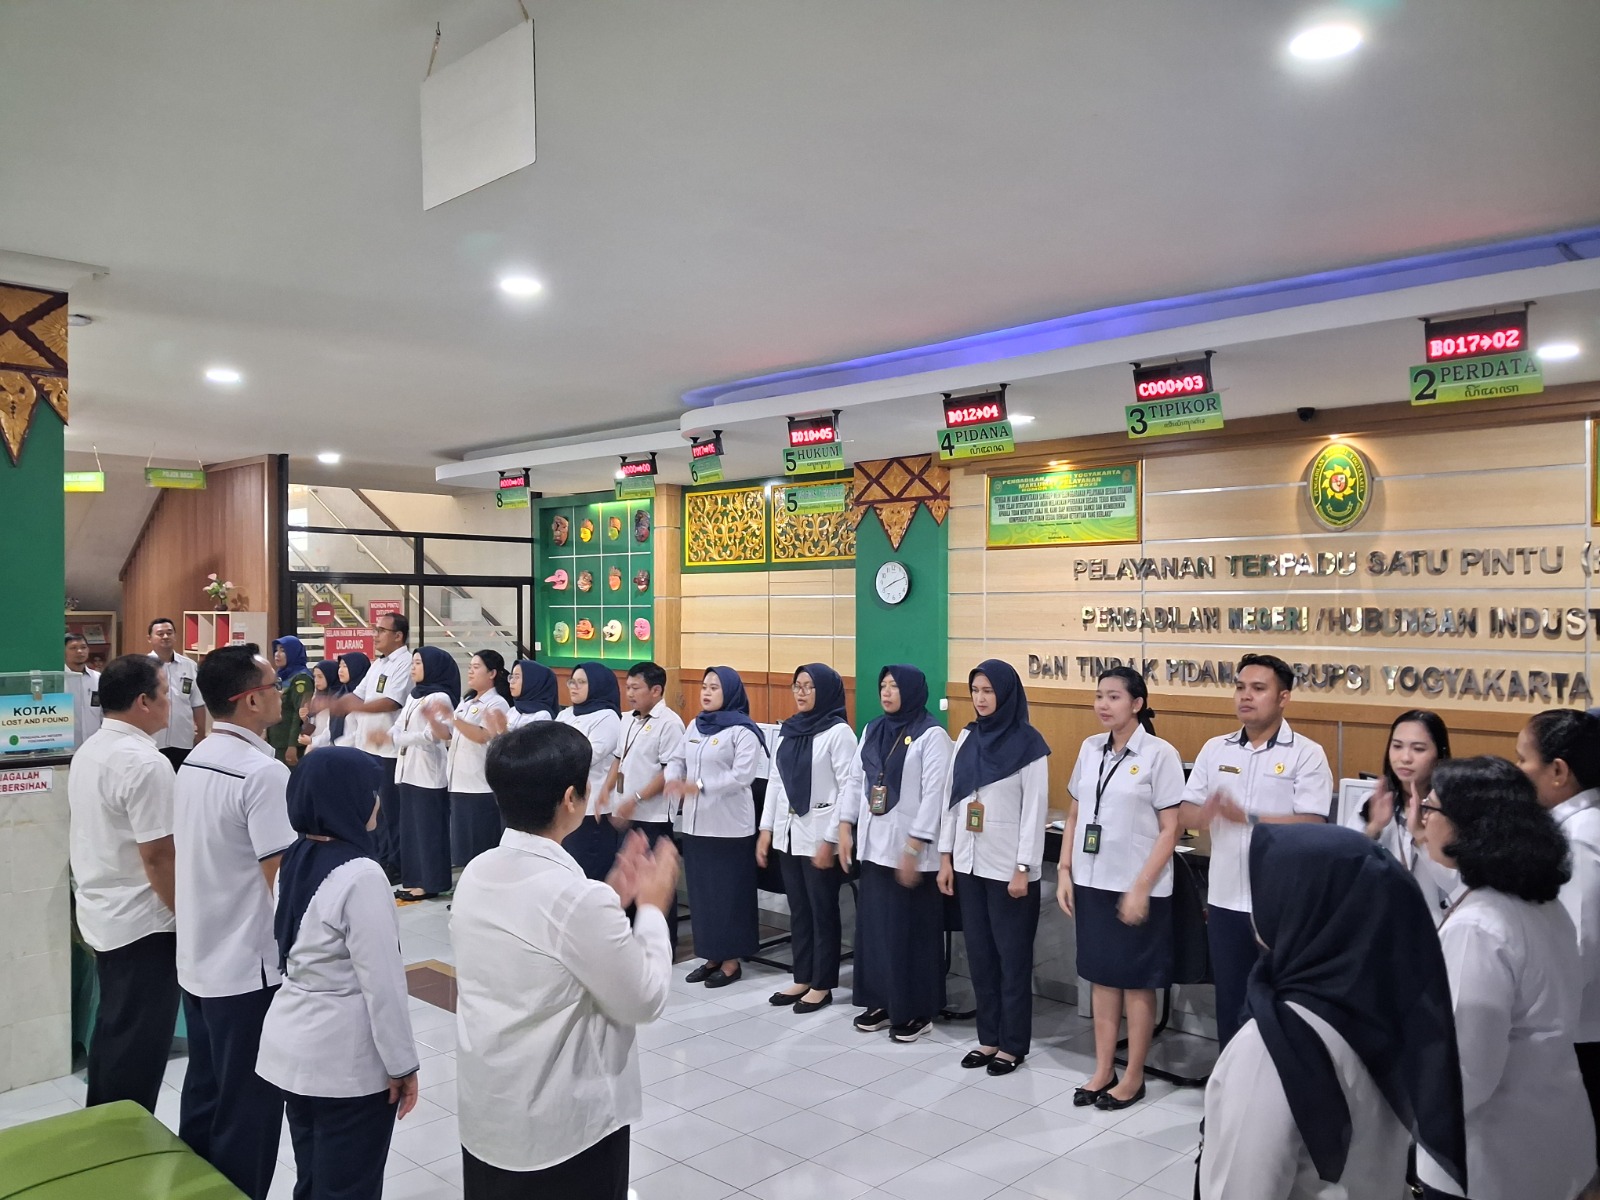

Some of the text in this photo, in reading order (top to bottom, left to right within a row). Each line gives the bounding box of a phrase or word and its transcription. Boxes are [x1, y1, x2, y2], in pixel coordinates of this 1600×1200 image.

[1493, 329, 1520, 349] 02
[1183, 375, 1204, 390] 03
[1413, 358, 1538, 401] 2 PERDATA
[982, 404, 999, 419] 04
[1130, 408, 1148, 434] 3
[1148, 397, 1218, 418] TIPIKOR
[941, 425, 1009, 456] 4 PIDANA
[785, 452, 797, 472] 5
[797, 446, 839, 460] HUKUM
[692, 465, 698, 482] 6
[1074, 470, 1121, 478] YOGYAKARTA
[496, 493, 503, 507] 8
[787, 493, 798, 512] 5
[1073, 555, 1215, 580] PELAYANAN
[1225, 551, 1356, 577] TERPADU
[1367, 548, 1450, 576] SATU
[1460, 546, 1564, 576] PINTU
[1081, 606, 1220, 632] PENGADILAN
[1228, 606, 1308, 631] NEGERI
[336, 639, 364, 650] DILARANG
[1028, 654, 1068, 677] DAN
[1166, 659, 1240, 685] PIDAN
[1292, 663, 1370, 691] RUPSI
[1381, 665, 1593, 701] YOGYAKARTA
[13, 705, 57, 717] KOTAK
[0, 771, 39, 781] AGALAH
[0, 781, 47, 792] BERSIHAN
